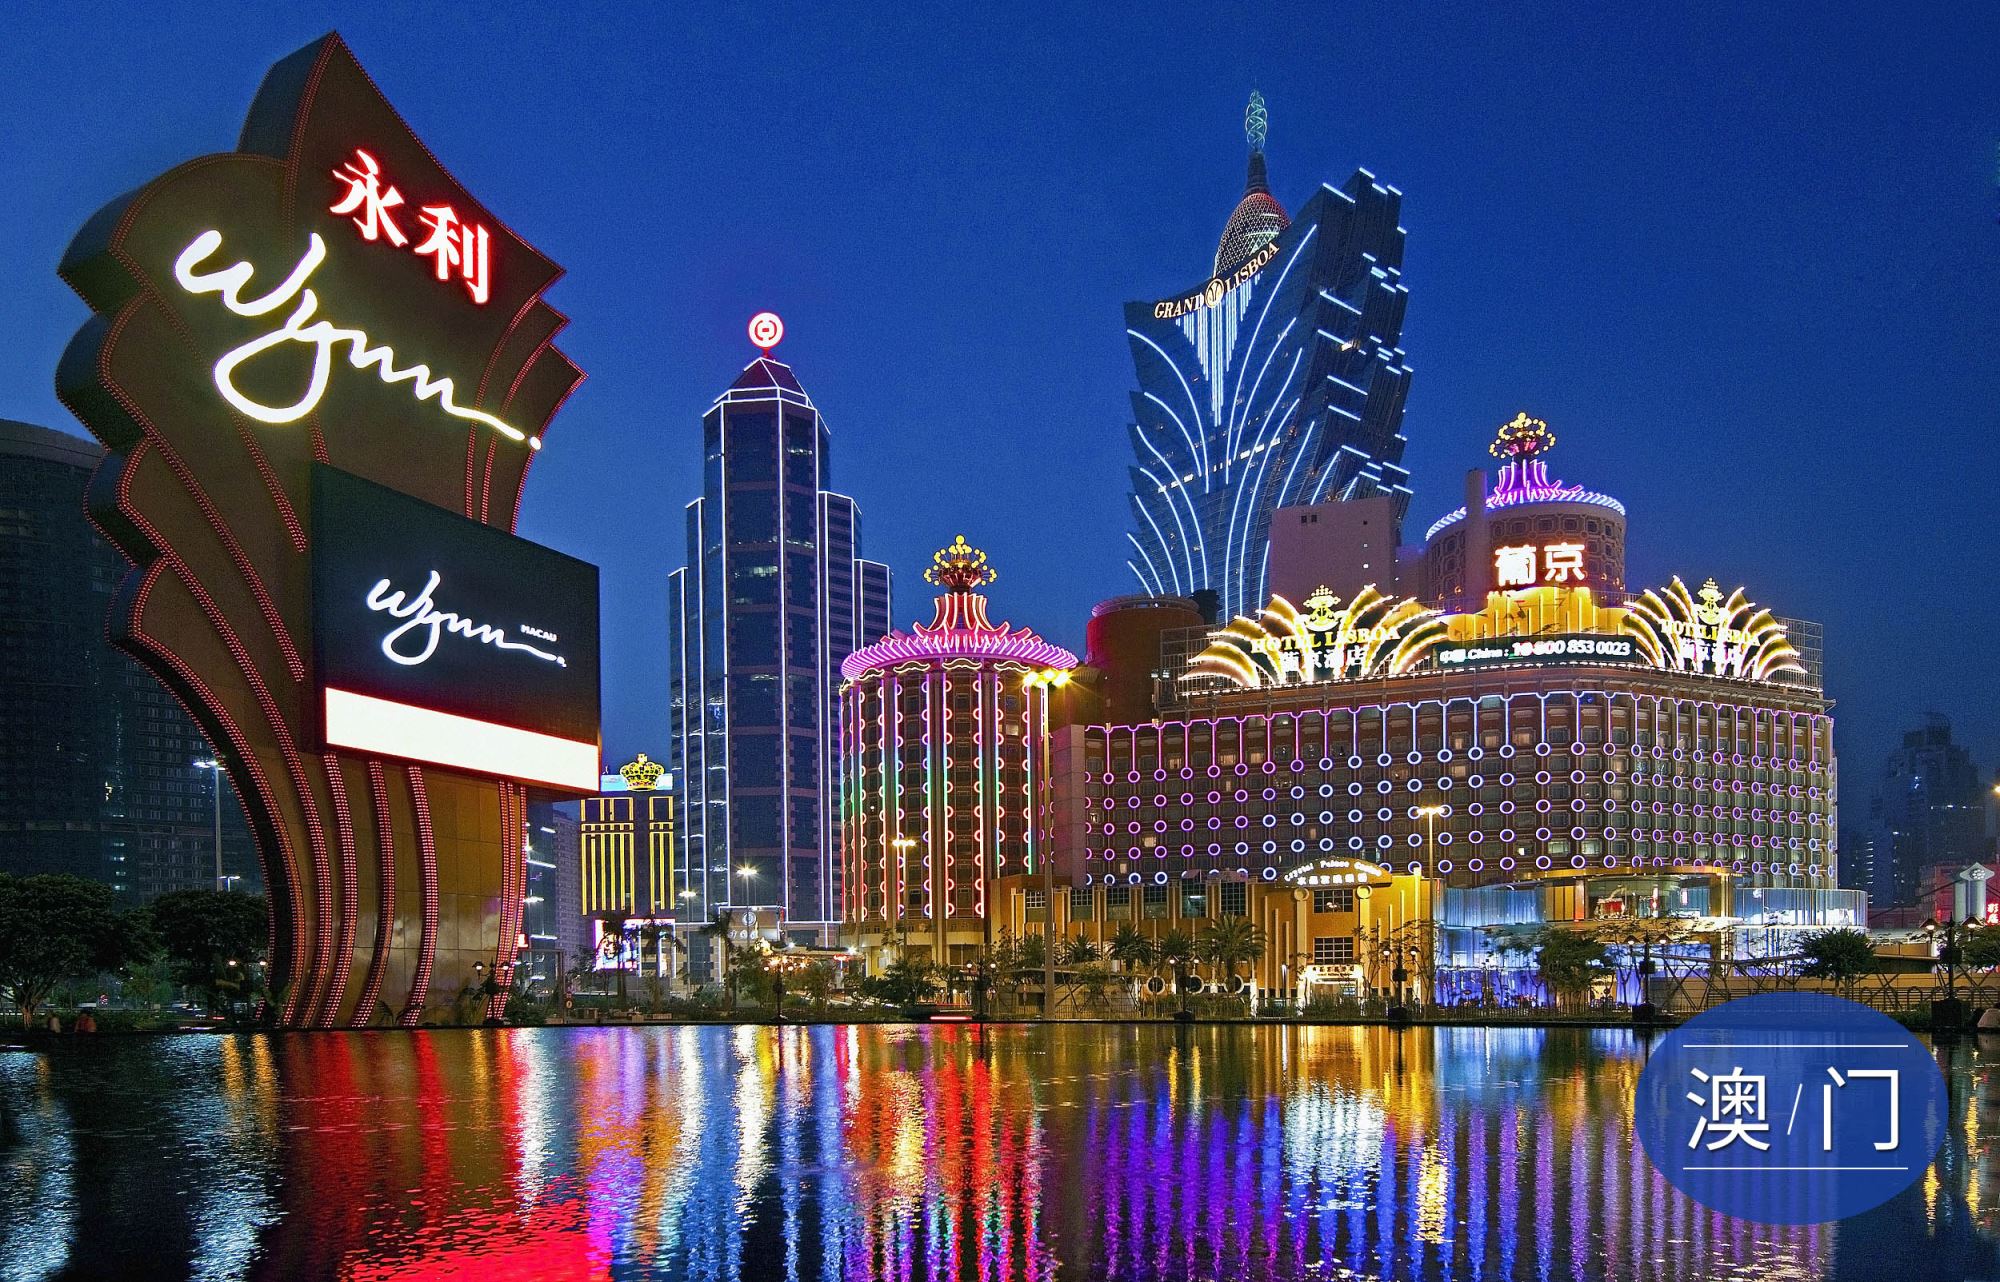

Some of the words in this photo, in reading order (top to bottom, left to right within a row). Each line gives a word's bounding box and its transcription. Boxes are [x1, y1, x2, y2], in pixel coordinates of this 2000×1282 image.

[329, 149, 491, 304] 永利
[1154, 294, 1205, 318] GRAND
[1225, 242, 1280, 293] LISBOA
[1495, 541, 1585, 587] 葡京
[521, 624, 558, 643] MACAU
[1325, 627, 1401, 646] LSBOA
[1566, 639, 1595, 654] 853
[1595, 641, 1631, 656] 0023
